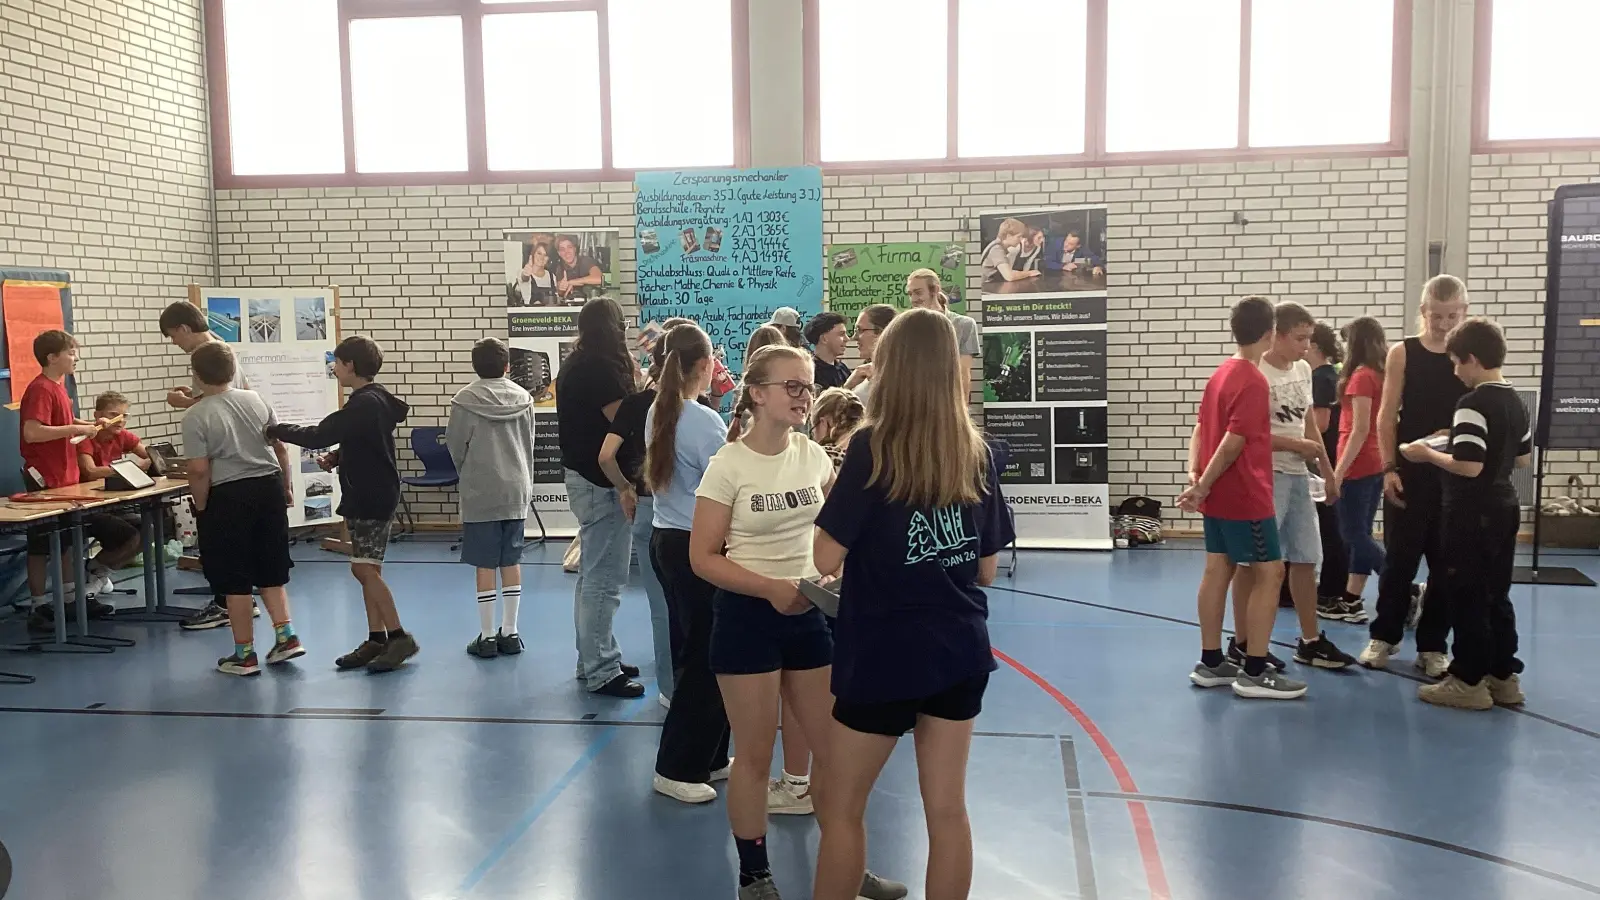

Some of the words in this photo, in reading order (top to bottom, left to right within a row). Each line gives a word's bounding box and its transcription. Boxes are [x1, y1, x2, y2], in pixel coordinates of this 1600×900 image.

[876, 244, 922, 264] Firma
[861, 269, 909, 283] Groenev
[674, 291, 690, 305] 30
[726, 304, 774, 321] Facharbeite
[1023, 302, 1030, 310] in
[1032, 302, 1043, 311] Dir
[1560, 396, 1600, 404] welcome
[750, 486, 820, 513] amour
[963, 550, 976, 562] 26
